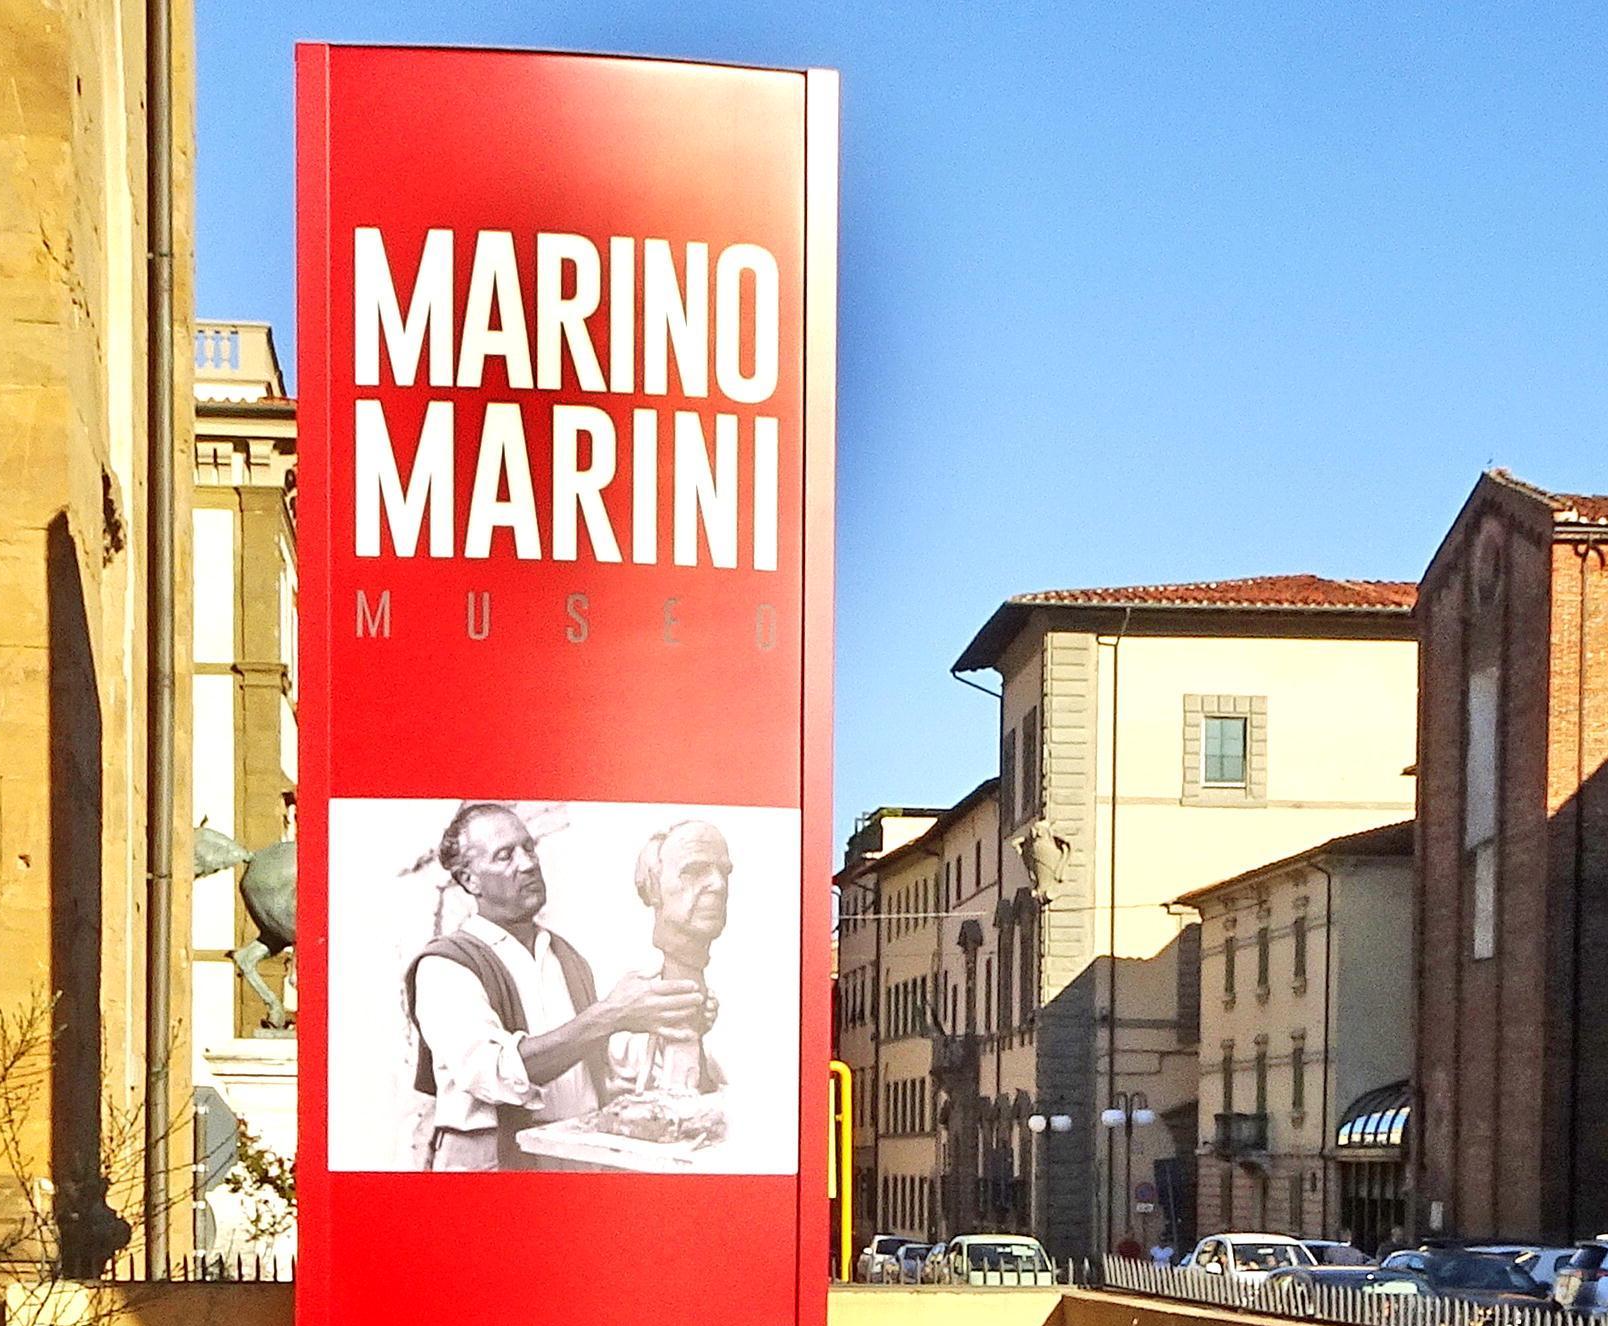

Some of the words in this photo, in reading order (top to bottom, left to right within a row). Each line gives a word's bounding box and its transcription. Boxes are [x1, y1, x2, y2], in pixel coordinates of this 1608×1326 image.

[354, 227, 780, 404] MARINO
[354, 400, 779, 571] MARINI
[355, 589, 778, 650] MUSEO
